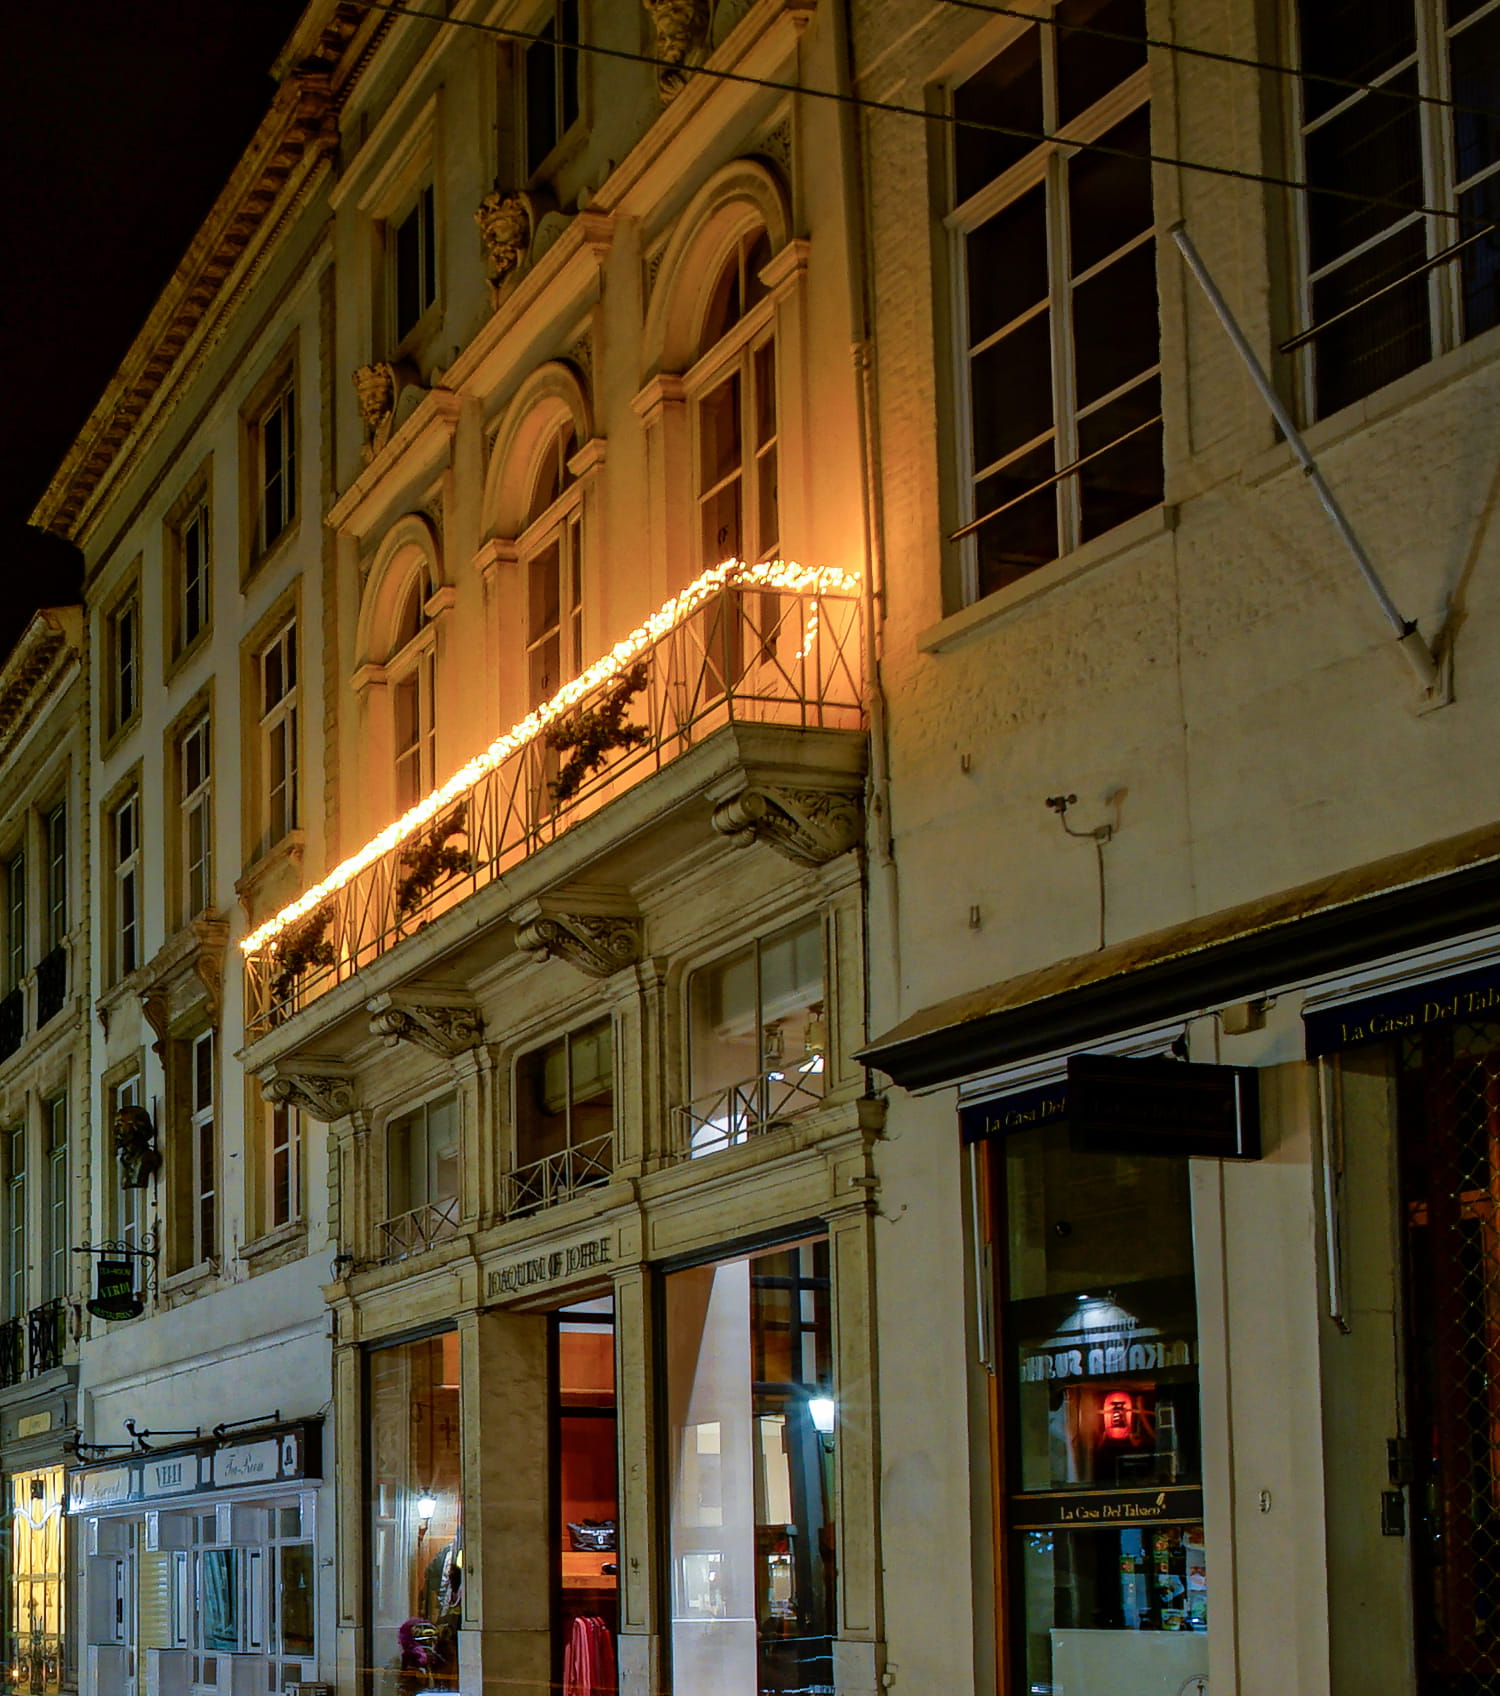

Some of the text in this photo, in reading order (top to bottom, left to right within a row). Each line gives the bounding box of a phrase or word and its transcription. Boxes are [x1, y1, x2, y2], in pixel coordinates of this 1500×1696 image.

[1340, 1023, 1365, 1043] La
[1369, 1012, 1415, 1034] Casa
[1424, 996, 1459, 1024] Del
[985, 1097, 1066, 1133] La Casa Del
[1060, 1503, 1161, 1520] La Casa Del Tabaco
[1259, 1490, 1272, 1514] 9
